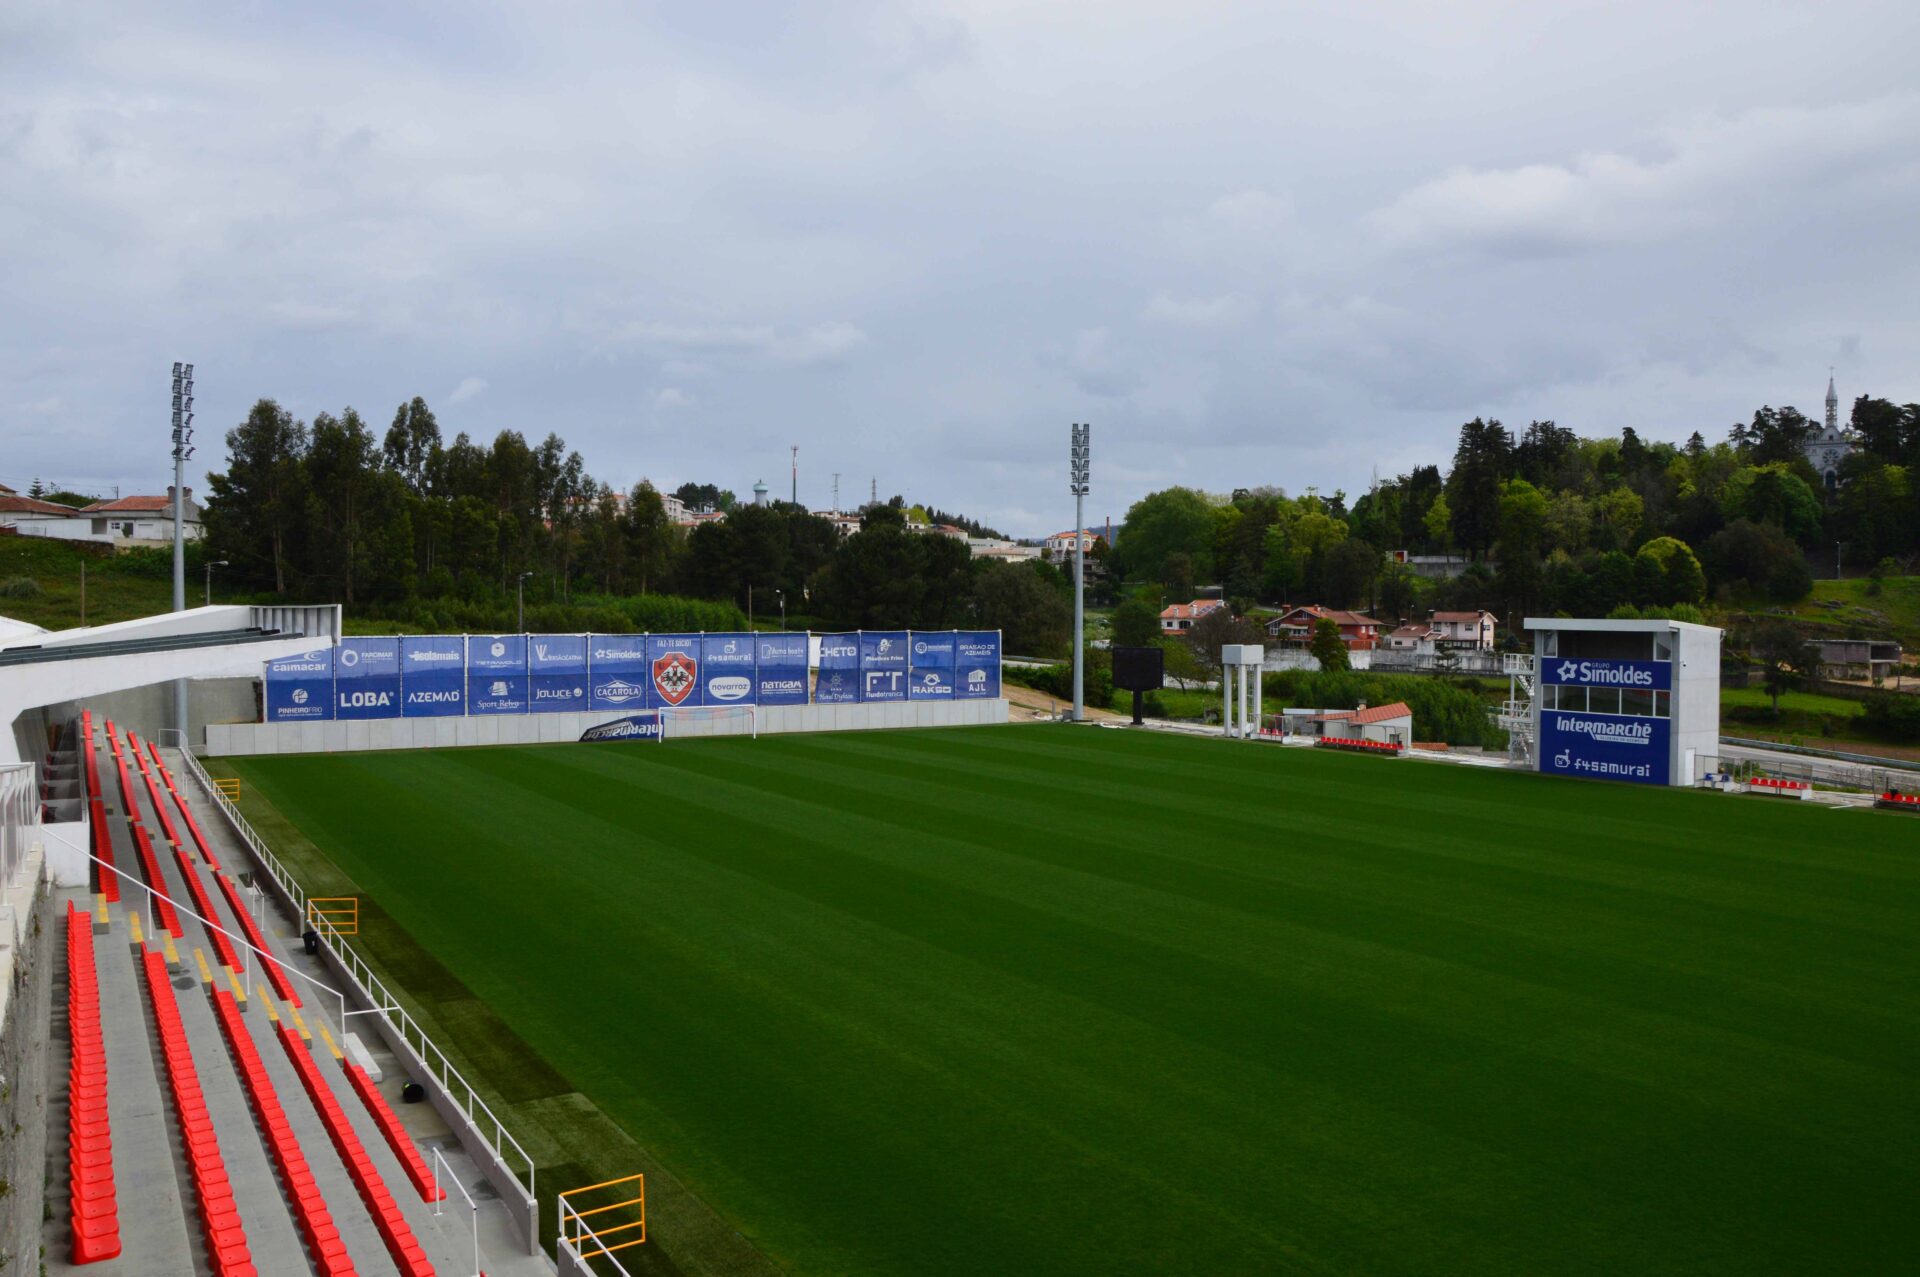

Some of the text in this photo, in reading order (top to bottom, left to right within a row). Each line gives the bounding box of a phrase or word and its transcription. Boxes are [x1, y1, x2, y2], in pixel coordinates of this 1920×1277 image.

[606, 650, 641, 659] Simoldes
[820, 646, 856, 656] CHETO
[273, 663, 327, 672] caimacar
[1580, 662, 1652, 684] Simoldes
[712, 682, 748, 690] novarroz
[341, 692, 390, 707] LOBA
[408, 692, 460, 703] AZEMAD
[477, 700, 496, 710] Sport
[1556, 716, 1652, 738] Intermarché
[1574, 758, 1650, 776] f4samurai
